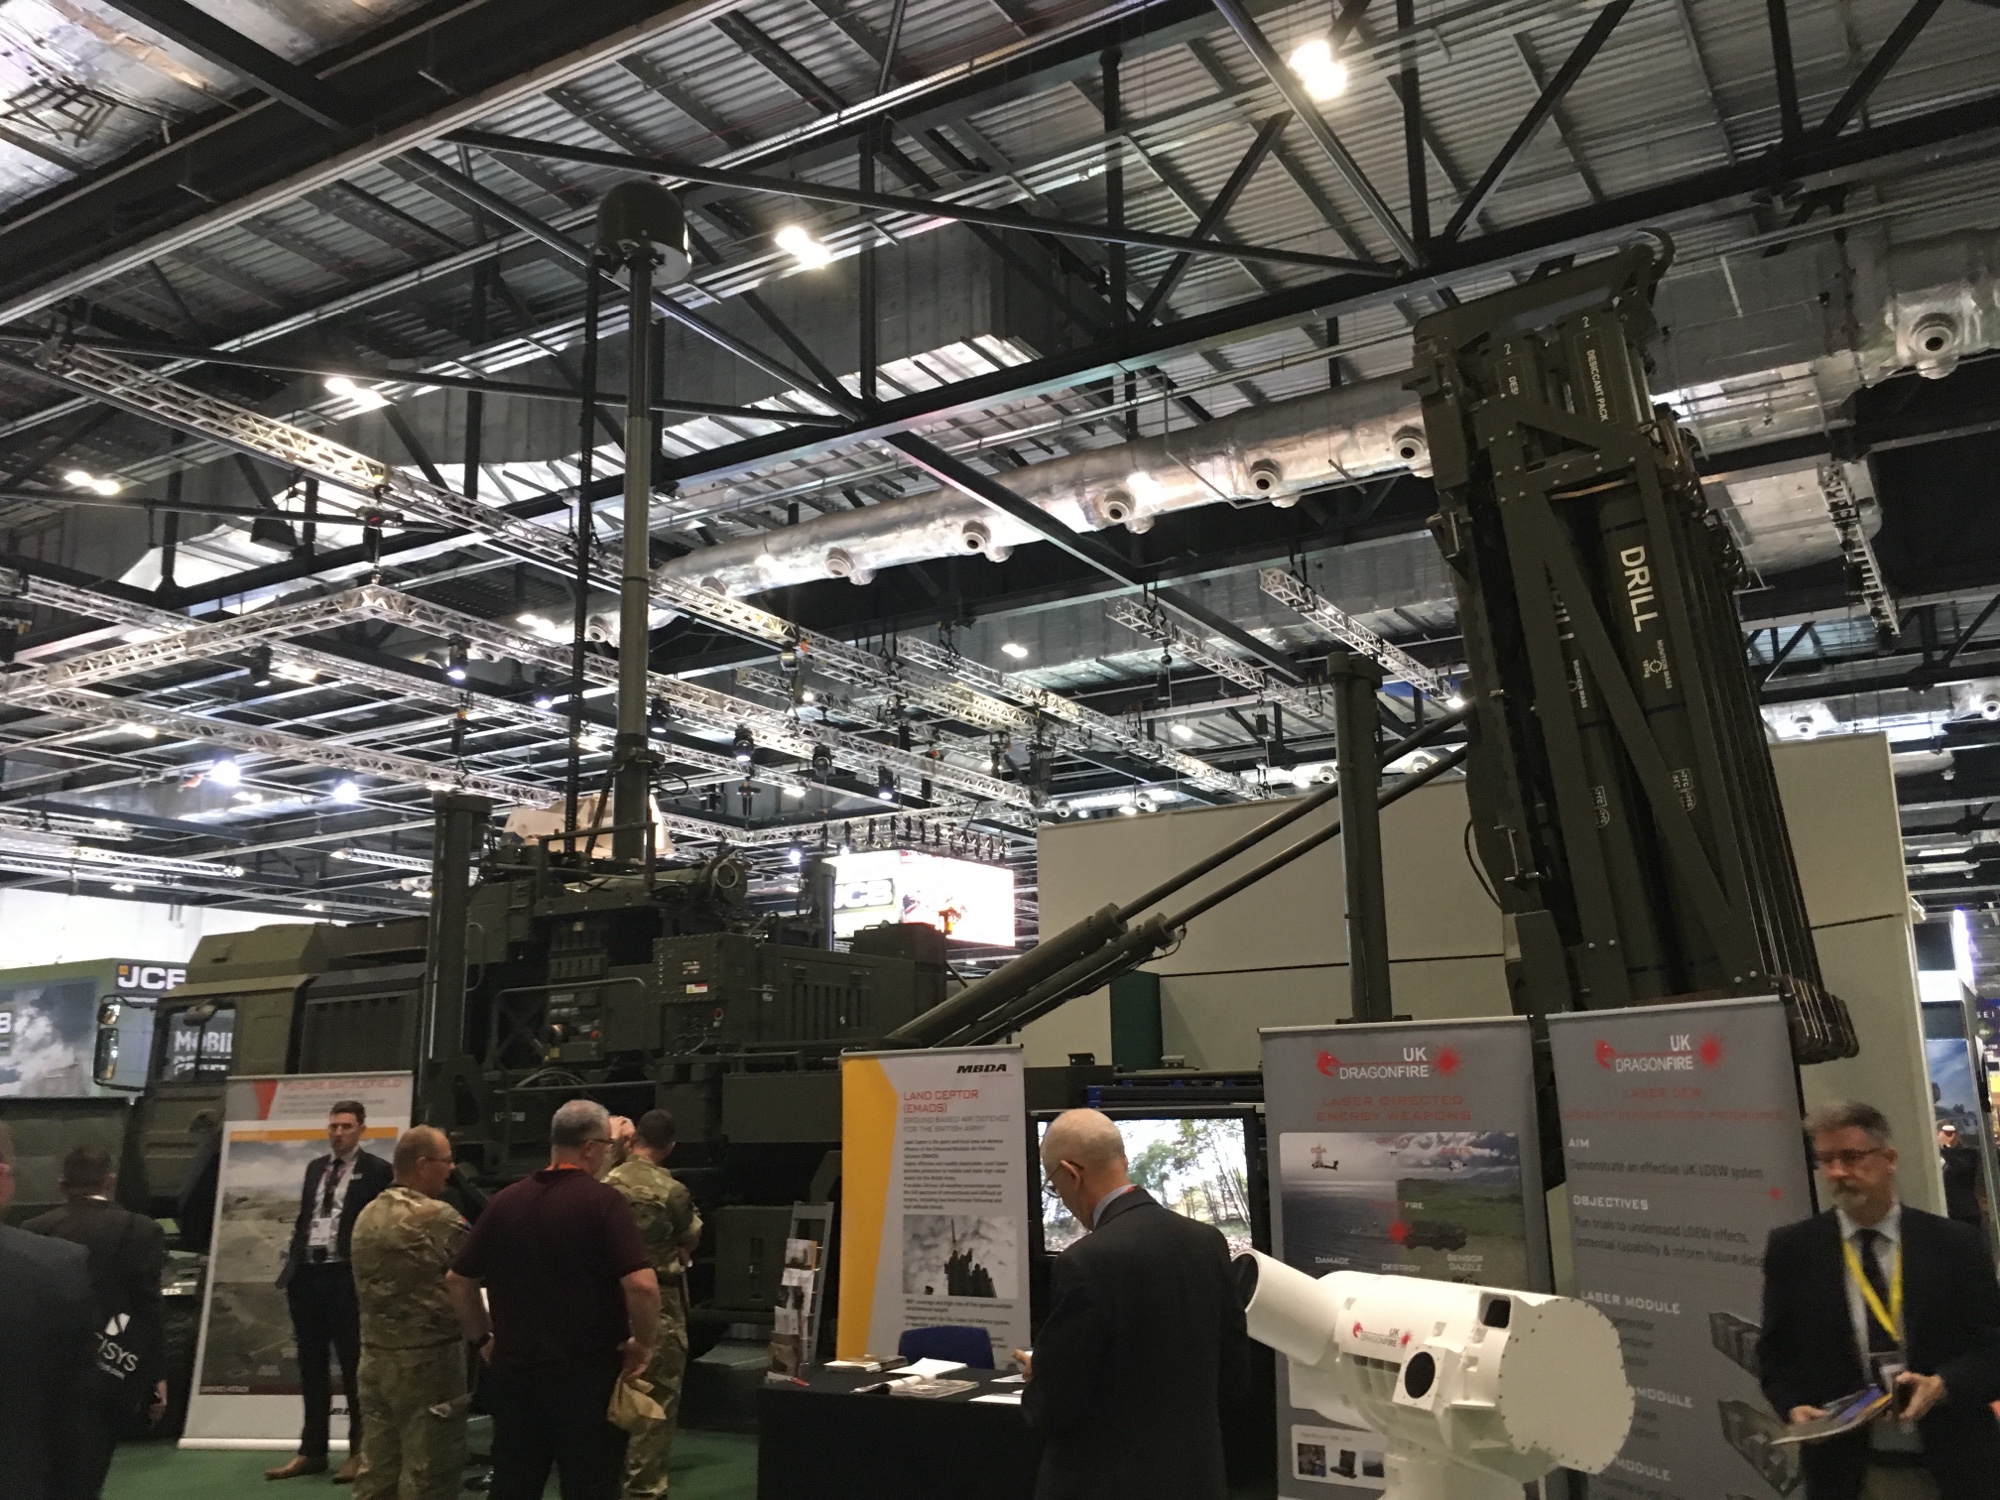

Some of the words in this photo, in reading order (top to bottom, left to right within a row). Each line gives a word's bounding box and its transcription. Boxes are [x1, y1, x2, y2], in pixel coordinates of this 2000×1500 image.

[1587, 349, 1604, 396] DESICCANT
[1596, 396, 1609, 422] PACK
[1620, 546, 1658, 633] DRILL
[1670, 1034, 1691, 1051] UK
[1403, 1047, 1427, 1061] UK
[957, 1063, 1007, 1073] MBDA
[1615, 1056, 1694, 1073] DRAGONFIRE
[1339, 1065, 1429, 1079] DRAGONFIRE
[903, 1090, 932, 1101] LAND
[935, 1089, 979, 1100] CEPTOR
[1379, 1094, 1464, 1106] DIRECTED
[903, 1103, 947, 1114] (EMADS)
[1387, 1110, 1471, 1121] WEAPONS
[1568, 1138, 1590, 1149] AIM
[1640, 1162, 1679, 1175] effective
[1682, 1164, 1696, 1176] UK
[1404, 1202, 1424, 1210] FIRE
[1573, 1195, 1649, 1211] OBJECTIVES
[1315, 1256, 1350, 1265] DAMAGE
[1381, 1263, 1421, 1272] DESTROY
[1581, 1291, 1621, 1306] LASER
[1625, 1297, 1681, 1315] MODULE
[1389, 1328, 1400, 1337] UK
[1635, 1386, 1693, 1409] MODULE
[1614, 1457, 1671, 1481] MODULE
